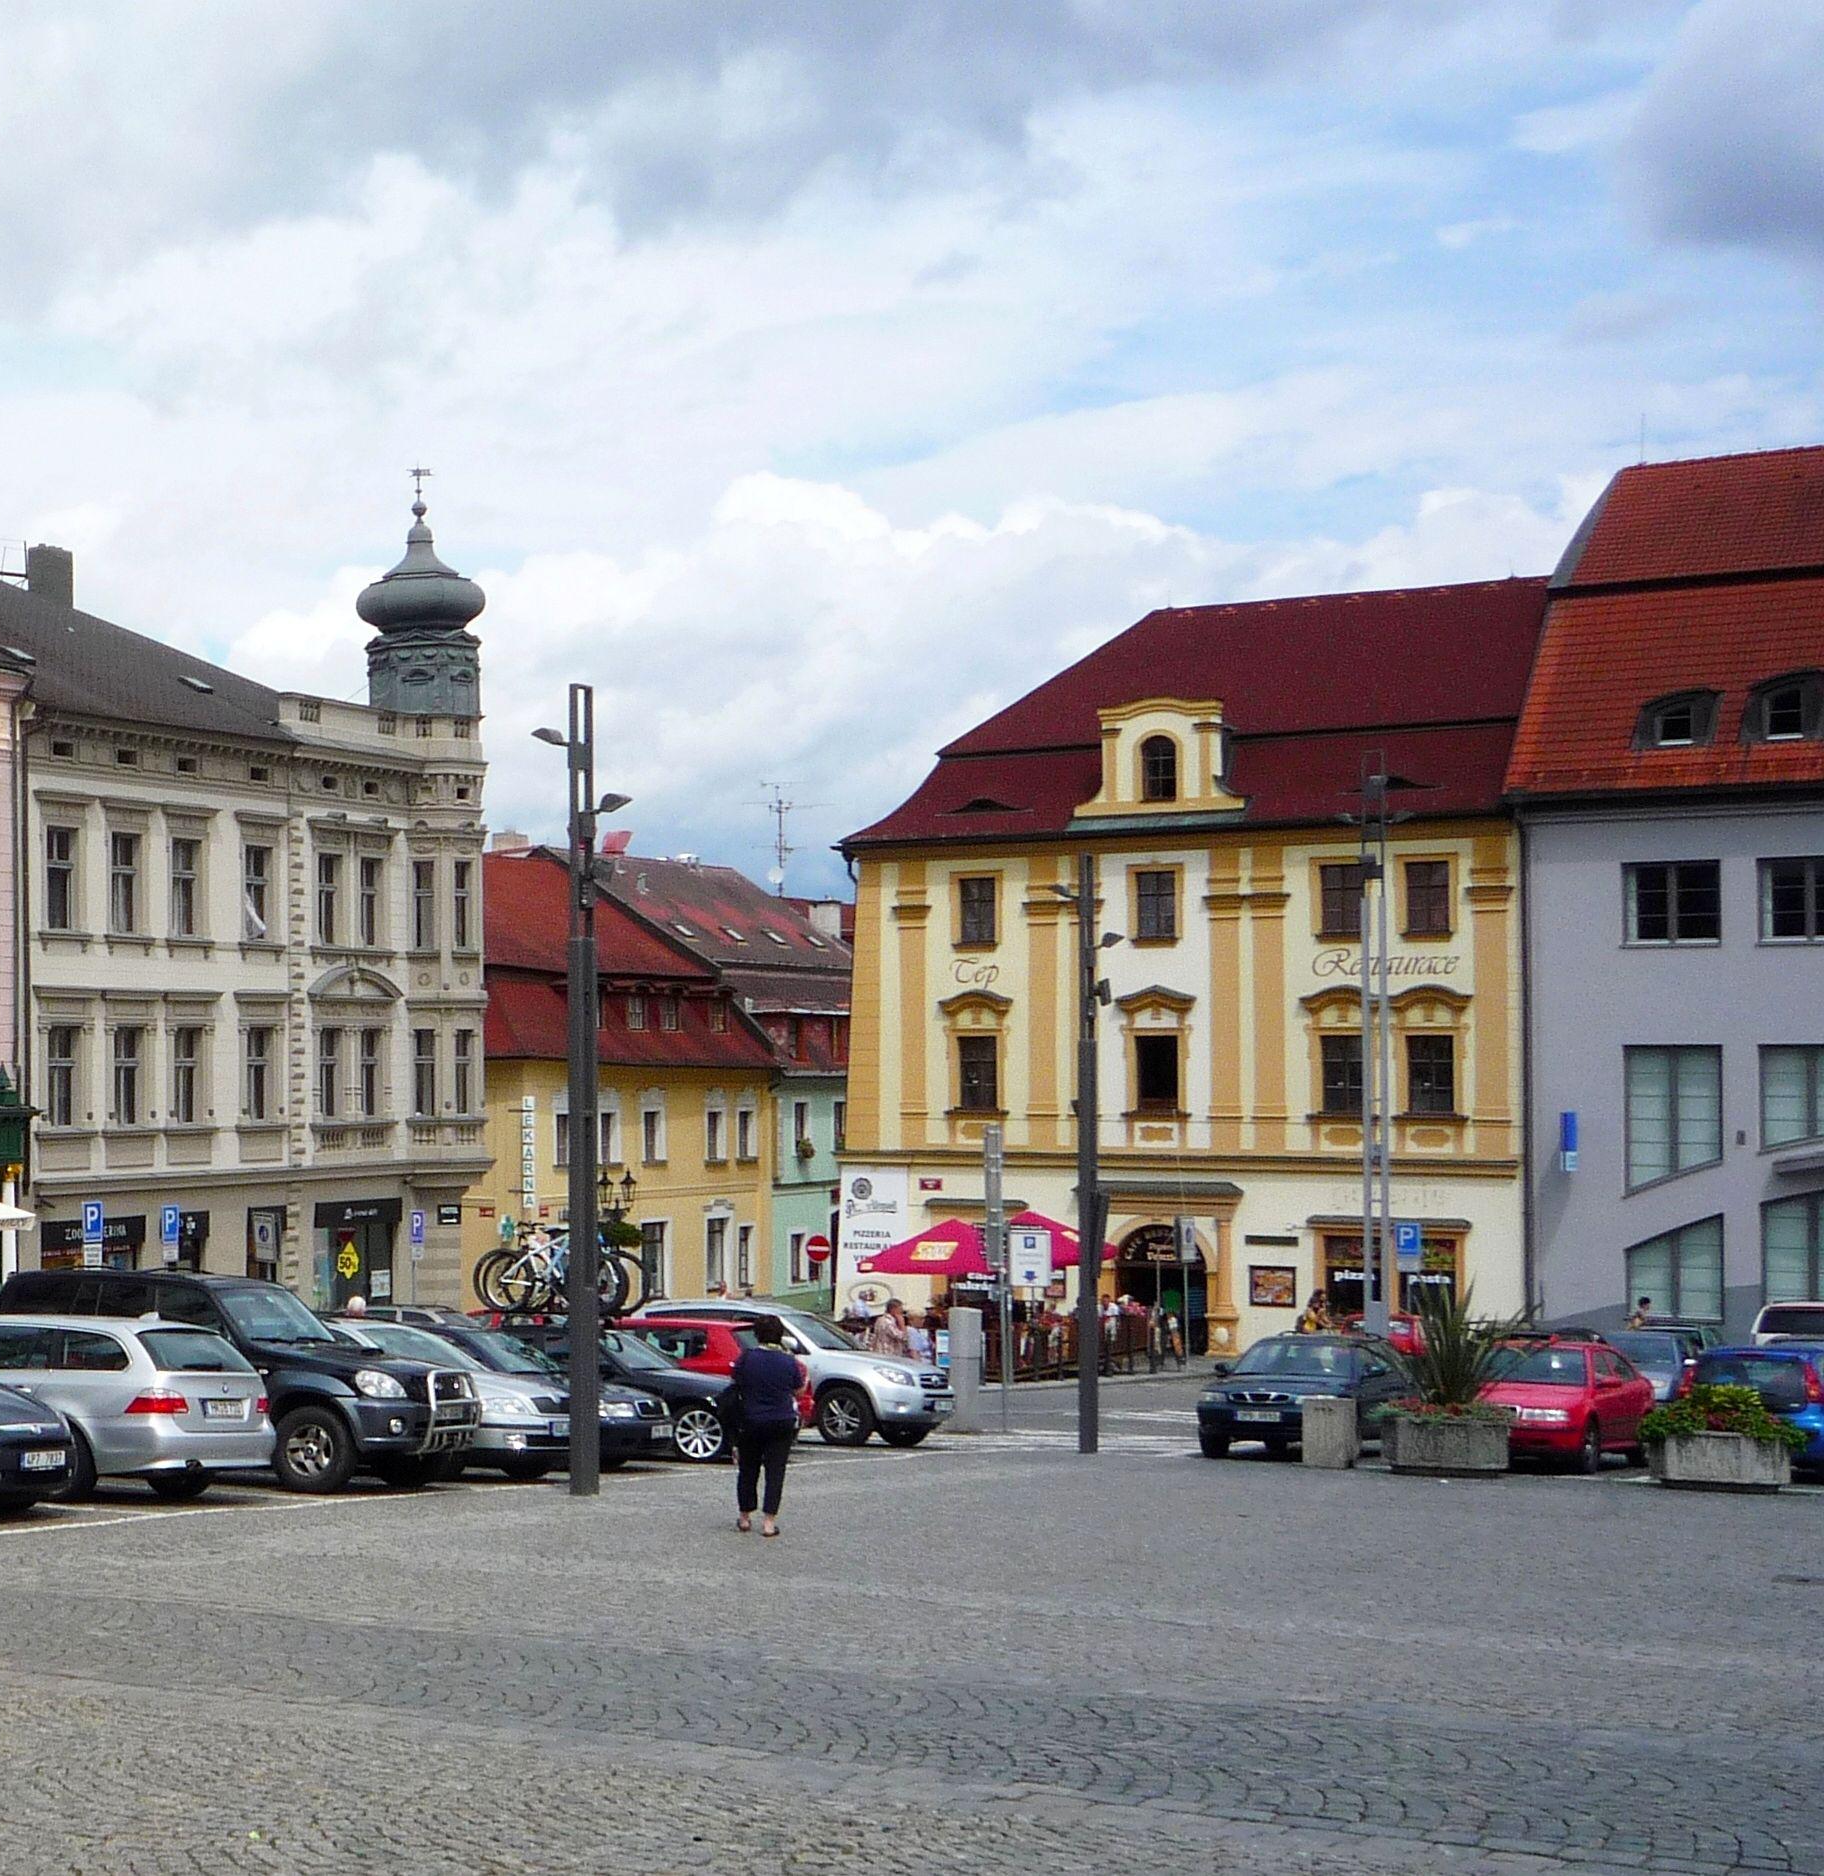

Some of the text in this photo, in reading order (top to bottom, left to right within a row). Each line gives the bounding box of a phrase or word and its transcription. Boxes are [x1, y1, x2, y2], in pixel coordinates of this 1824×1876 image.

[87, 1206, 98, 1230] P
[165, 1210, 175, 1232] P
[853, 1230, 892, 1238] PIZZERIA
[1399, 1227, 1414, 1246] P
